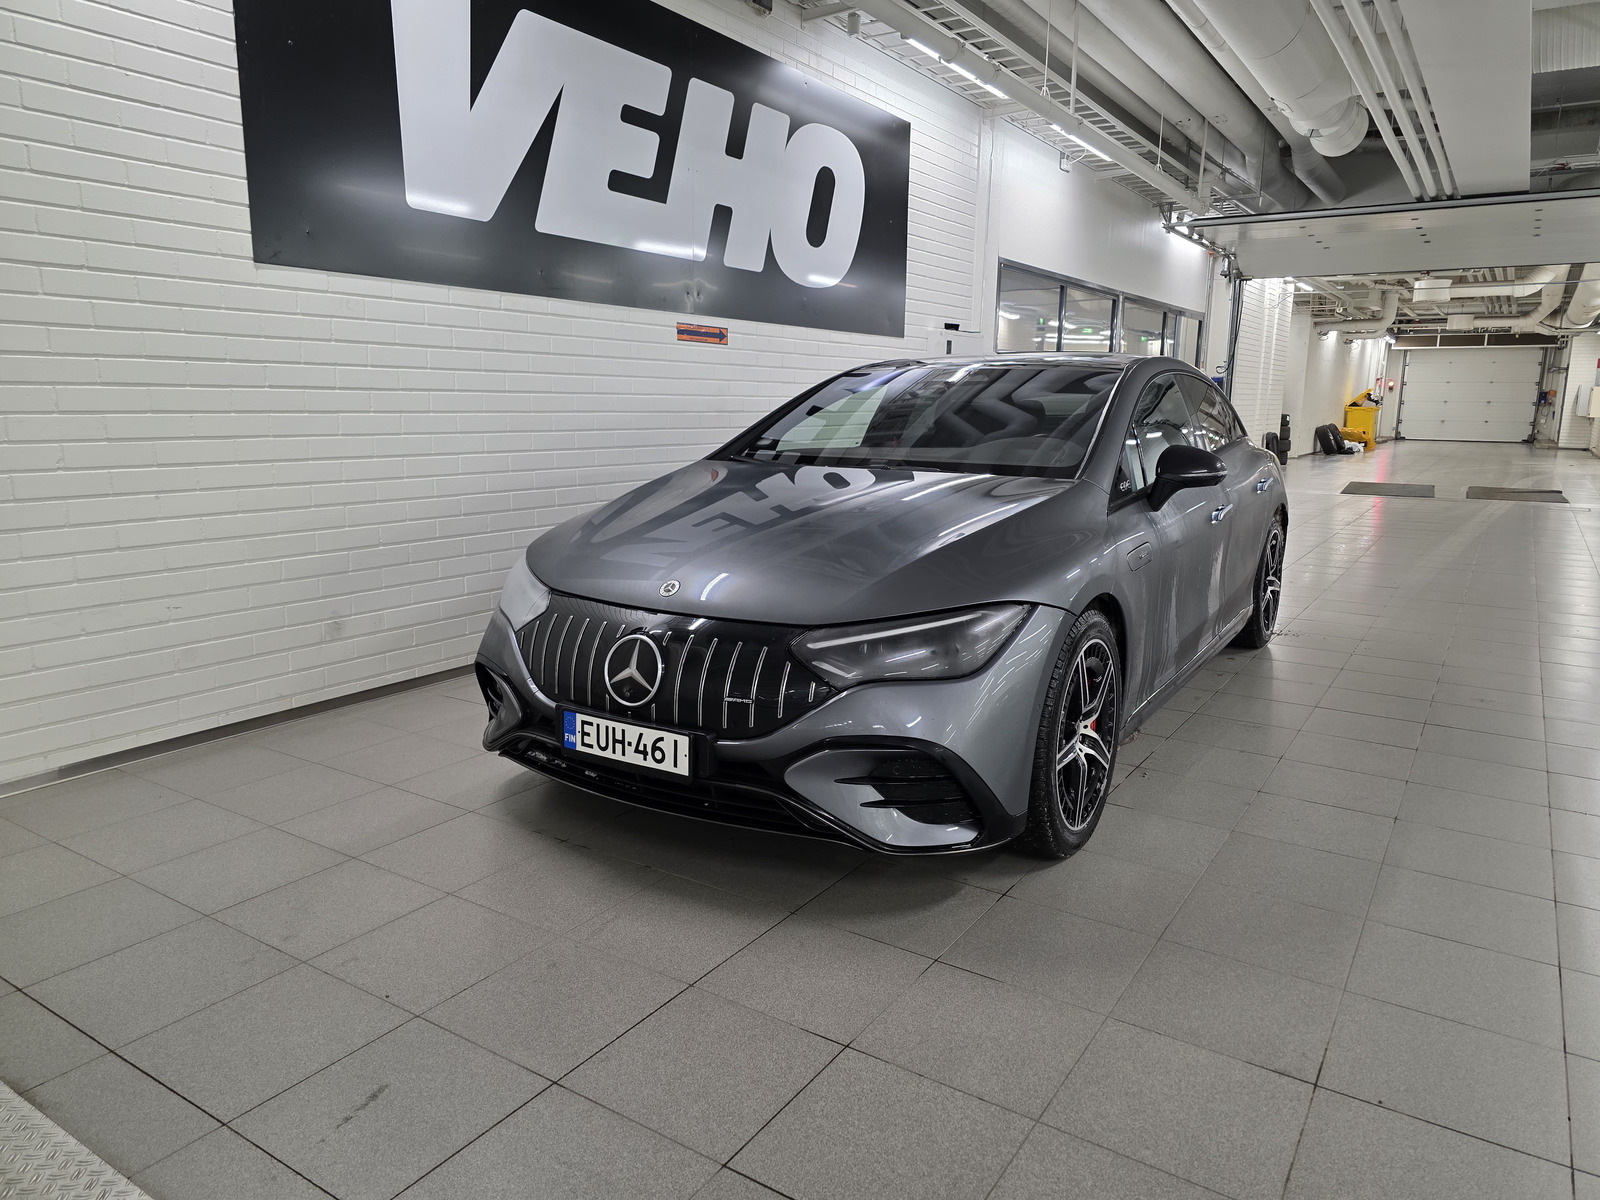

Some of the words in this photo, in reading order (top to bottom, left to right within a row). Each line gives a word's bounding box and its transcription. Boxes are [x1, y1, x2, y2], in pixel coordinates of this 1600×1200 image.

[391, 0, 866, 288] VEHO
[564, 733, 576, 743] FIN
[580, 719, 678, 769] EUH-461
